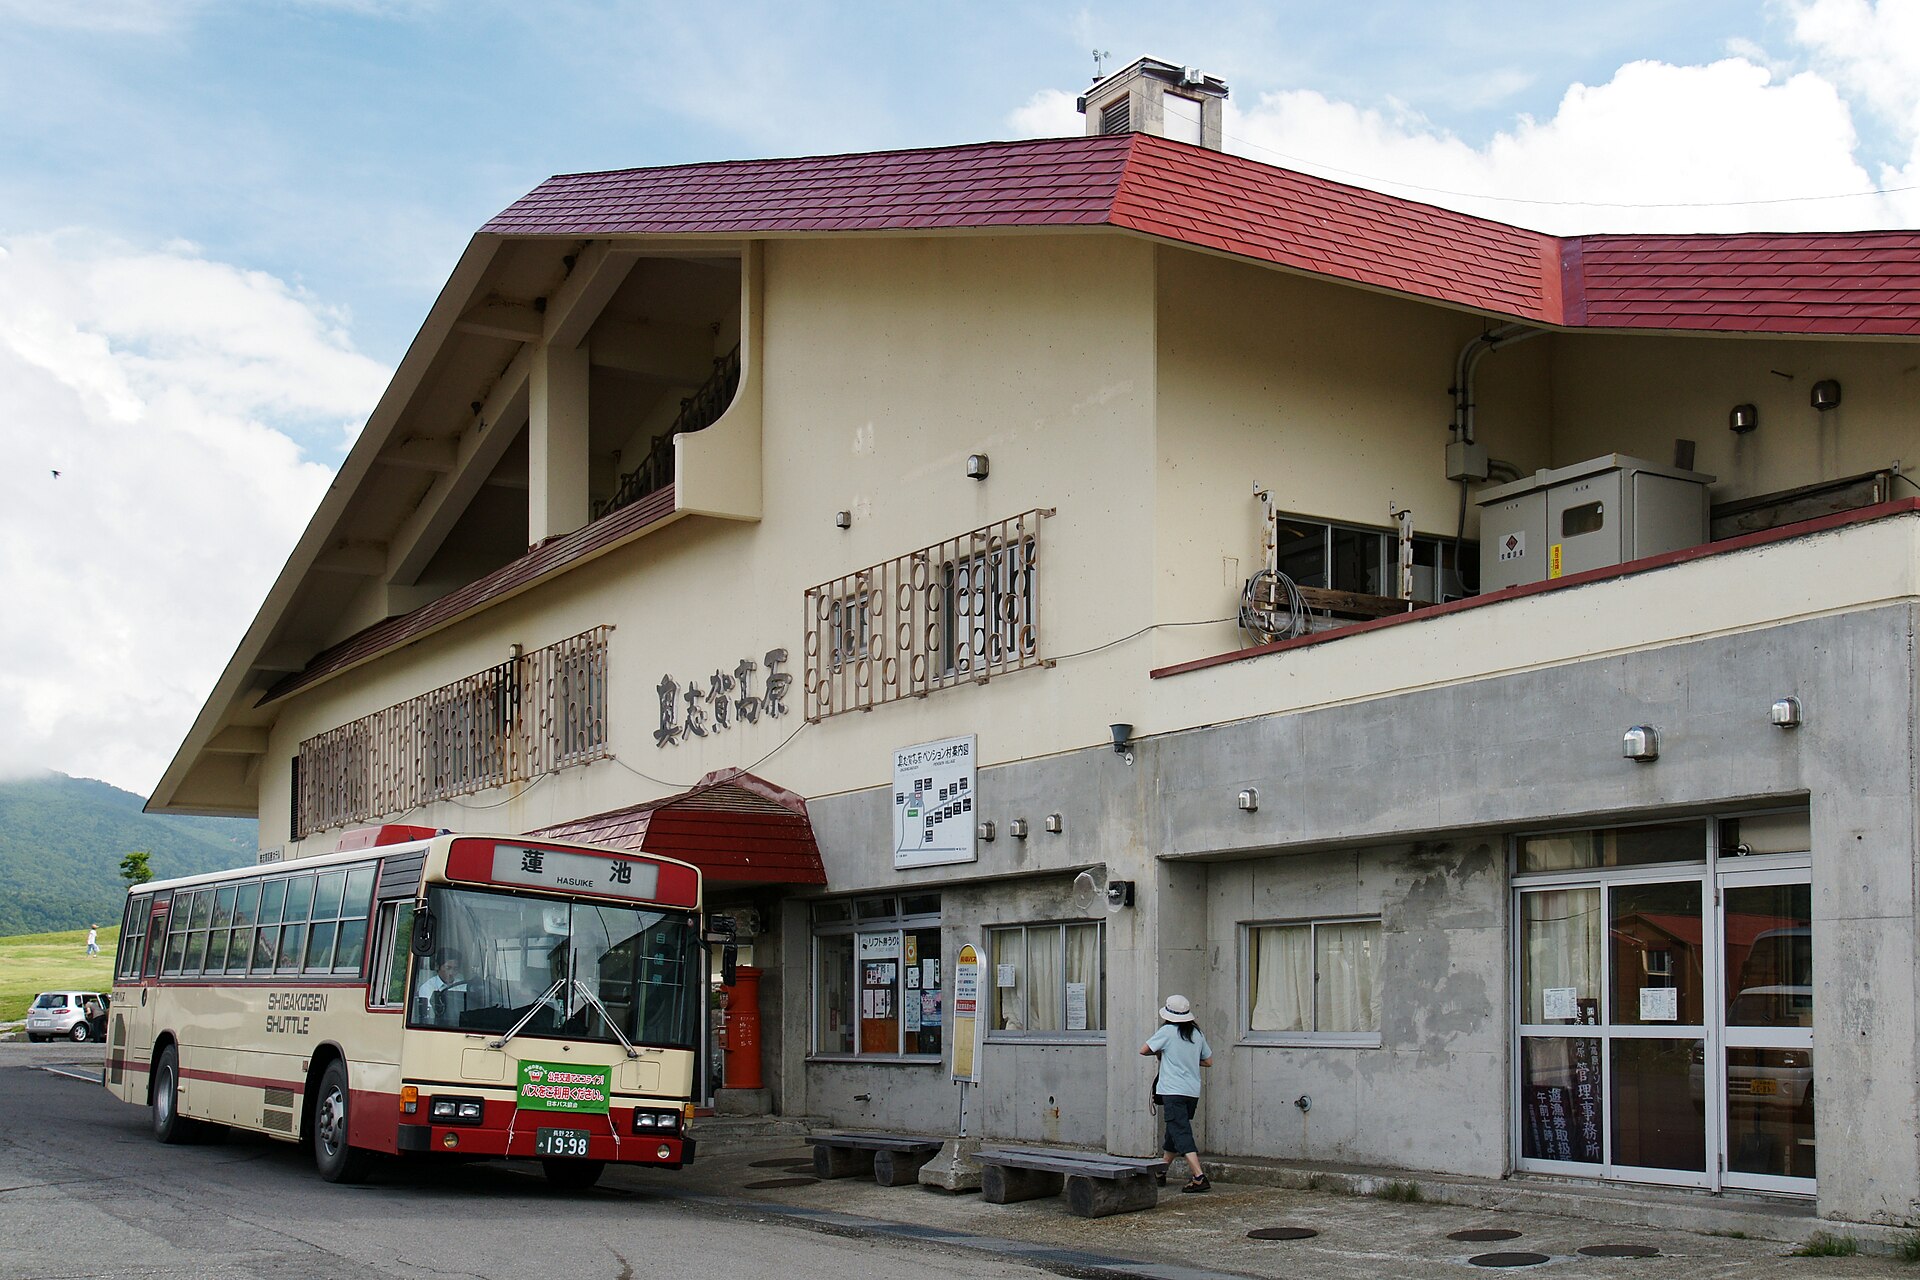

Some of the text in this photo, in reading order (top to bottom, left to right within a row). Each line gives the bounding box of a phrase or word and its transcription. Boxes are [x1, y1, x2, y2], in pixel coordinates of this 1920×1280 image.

[556, 876, 594, 888] HASUIKE
[267, 992, 328, 1012] SHIGAKOGEN
[266, 1015, 310, 1035] SHUTTLE
[521, 1083, 605, 1102] バスをご利用ください。
[1575, 1062, 1601, 1159] 管理事務所
[546, 1136, 587, 1155] 19-98
